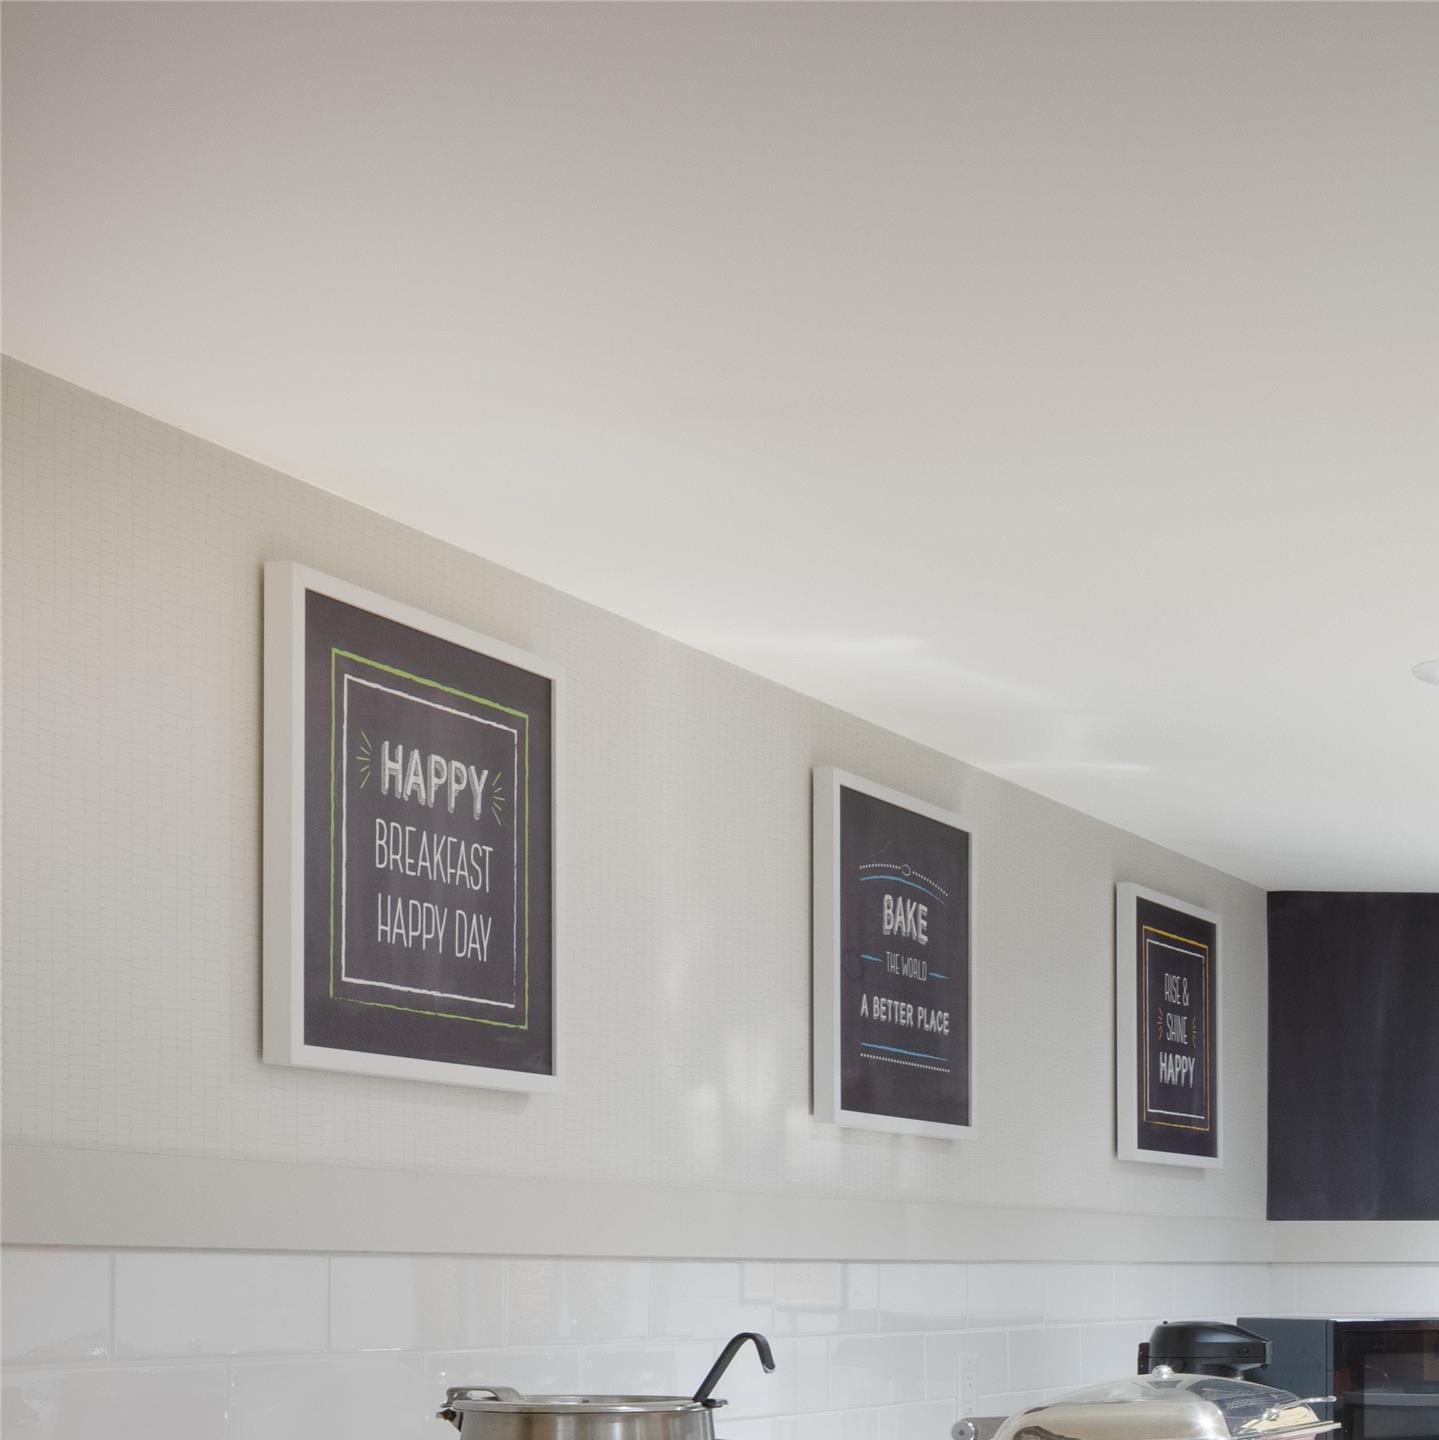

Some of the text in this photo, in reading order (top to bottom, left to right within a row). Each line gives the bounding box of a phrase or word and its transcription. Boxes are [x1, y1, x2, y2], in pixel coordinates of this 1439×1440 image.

[380, 739, 489, 821] HAPPY
[375, 818, 494, 894] BREAKFAST
[377, 892, 493, 963] HAPPY DAY
[882, 894, 929, 945] BAKE
[886, 951, 928, 982] THE WORLD
[1164, 973, 1190, 1007] RISE &
[860, 993, 950, 1036] A BETTER PLACE
[1166, 1012, 1188, 1045] SHINE
[1159, 1051, 1196, 1088] HAPPY
